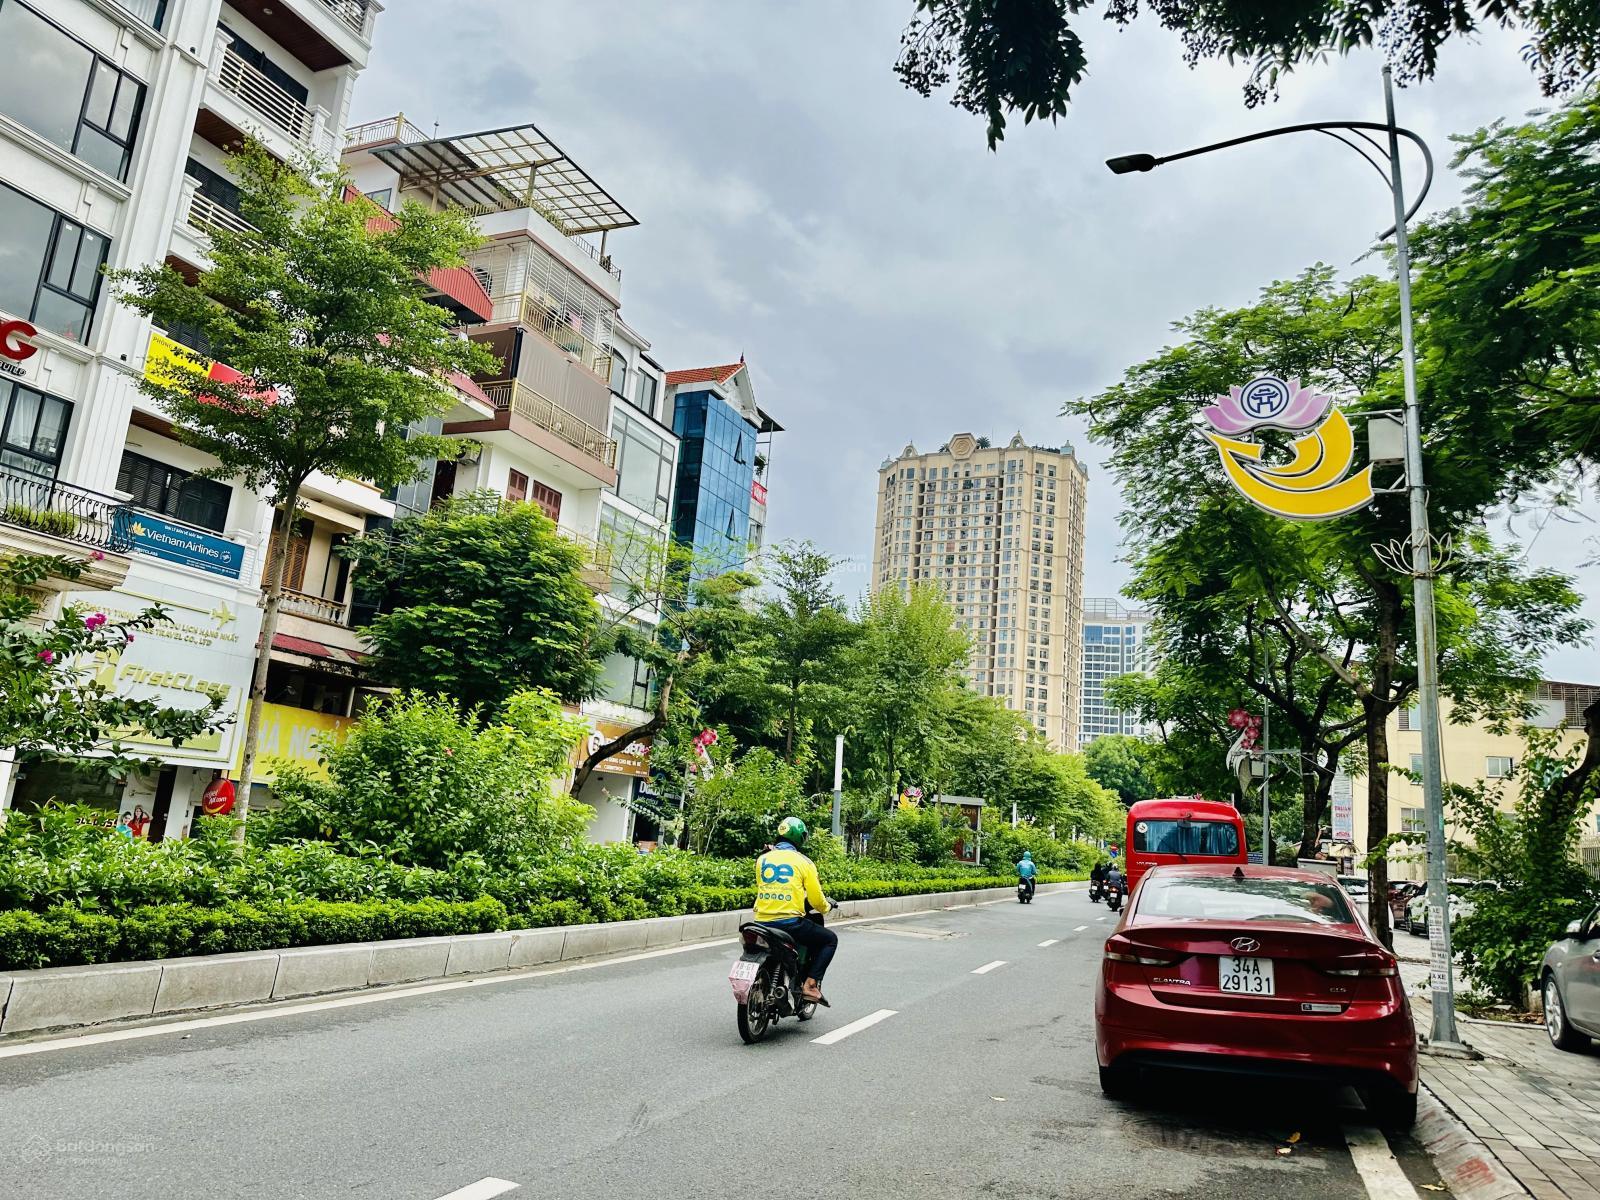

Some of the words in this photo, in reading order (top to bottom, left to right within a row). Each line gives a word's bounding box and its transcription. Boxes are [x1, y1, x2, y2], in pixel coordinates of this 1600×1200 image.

[146, 528, 187, 548] Vietnam
[184, 541, 220, 559] Airlines
[761, 858, 794, 884] be
[1232, 959, 1260, 976] 34A
[1153, 977, 1192, 986] ELANTRA
[1222, 974, 1272, 994] 291.31
